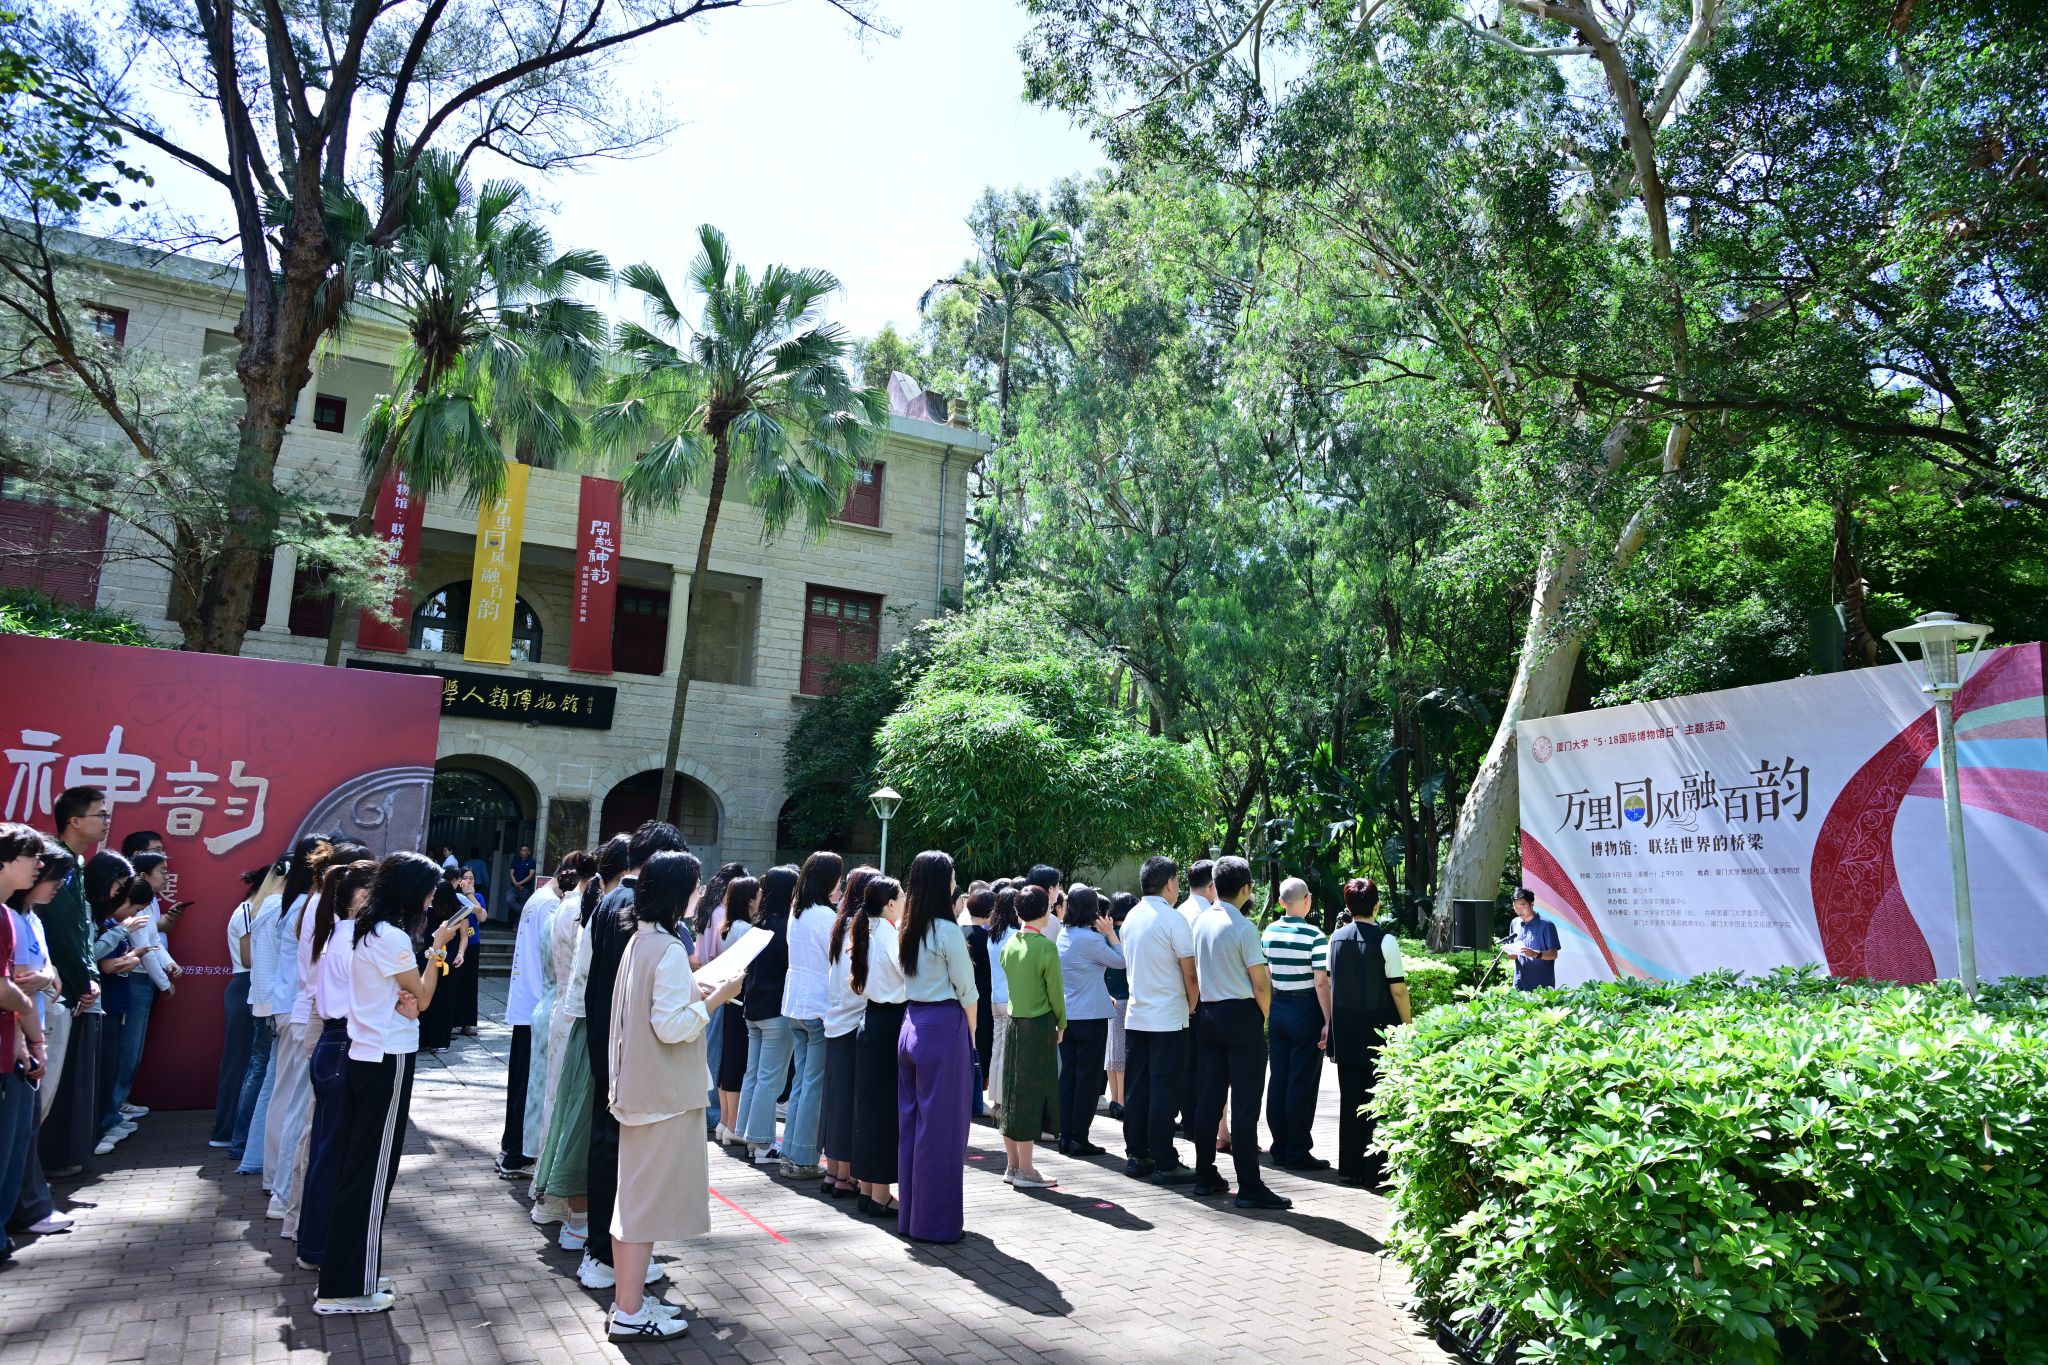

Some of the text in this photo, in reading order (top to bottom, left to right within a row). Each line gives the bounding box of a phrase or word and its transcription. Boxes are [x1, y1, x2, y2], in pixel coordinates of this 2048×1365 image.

[478, 497, 512, 621] 万里同风融百韵
[4, 725, 269, 855] 神韵
[1555, 755, 1811, 834] 万里同风融百韵
[1590, 833, 1764, 857] 博物馆：联结世界的桥梁
[180, 965, 234, 975] 历史与文化
